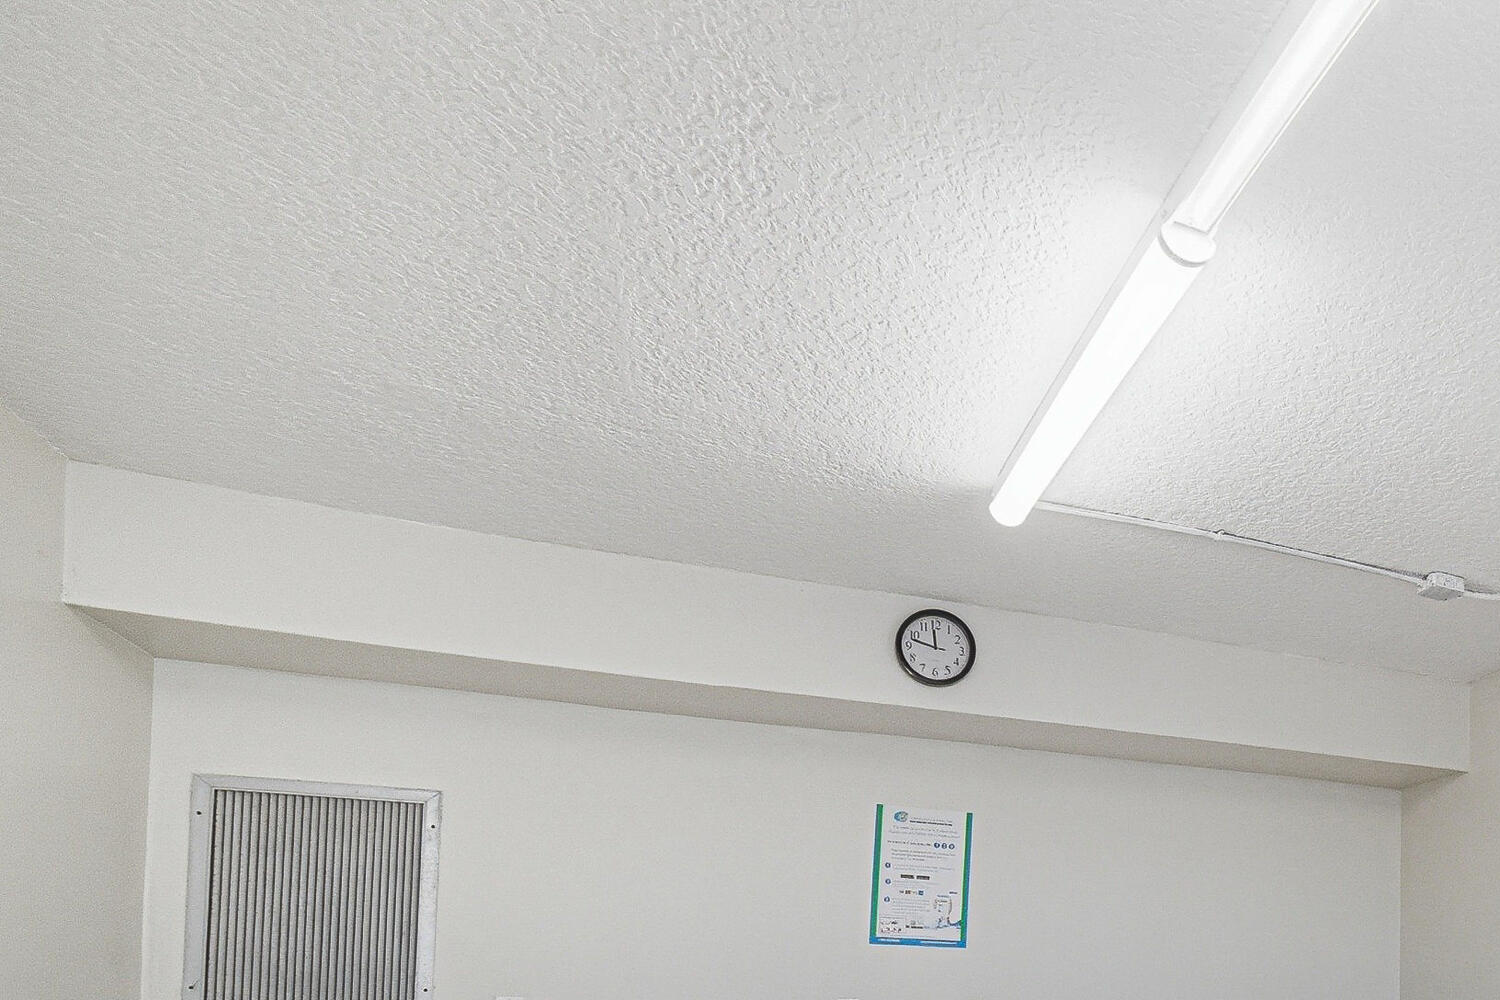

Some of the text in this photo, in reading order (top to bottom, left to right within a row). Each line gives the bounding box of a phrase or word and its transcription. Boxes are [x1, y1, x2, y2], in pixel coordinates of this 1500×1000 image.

[920, 621, 928, 632] 11
[930, 619, 941, 631] 12
[954, 634, 961, 645] 2
[905, 641, 912, 650] 9
[959, 646, 965, 656] 3
[909, 653, 917, 663] 8
[953, 658, 959, 666] 4
[919, 663, 926, 672] 7
[931, 667, 939, 678] 6
[944, 665, 951, 676] 5
